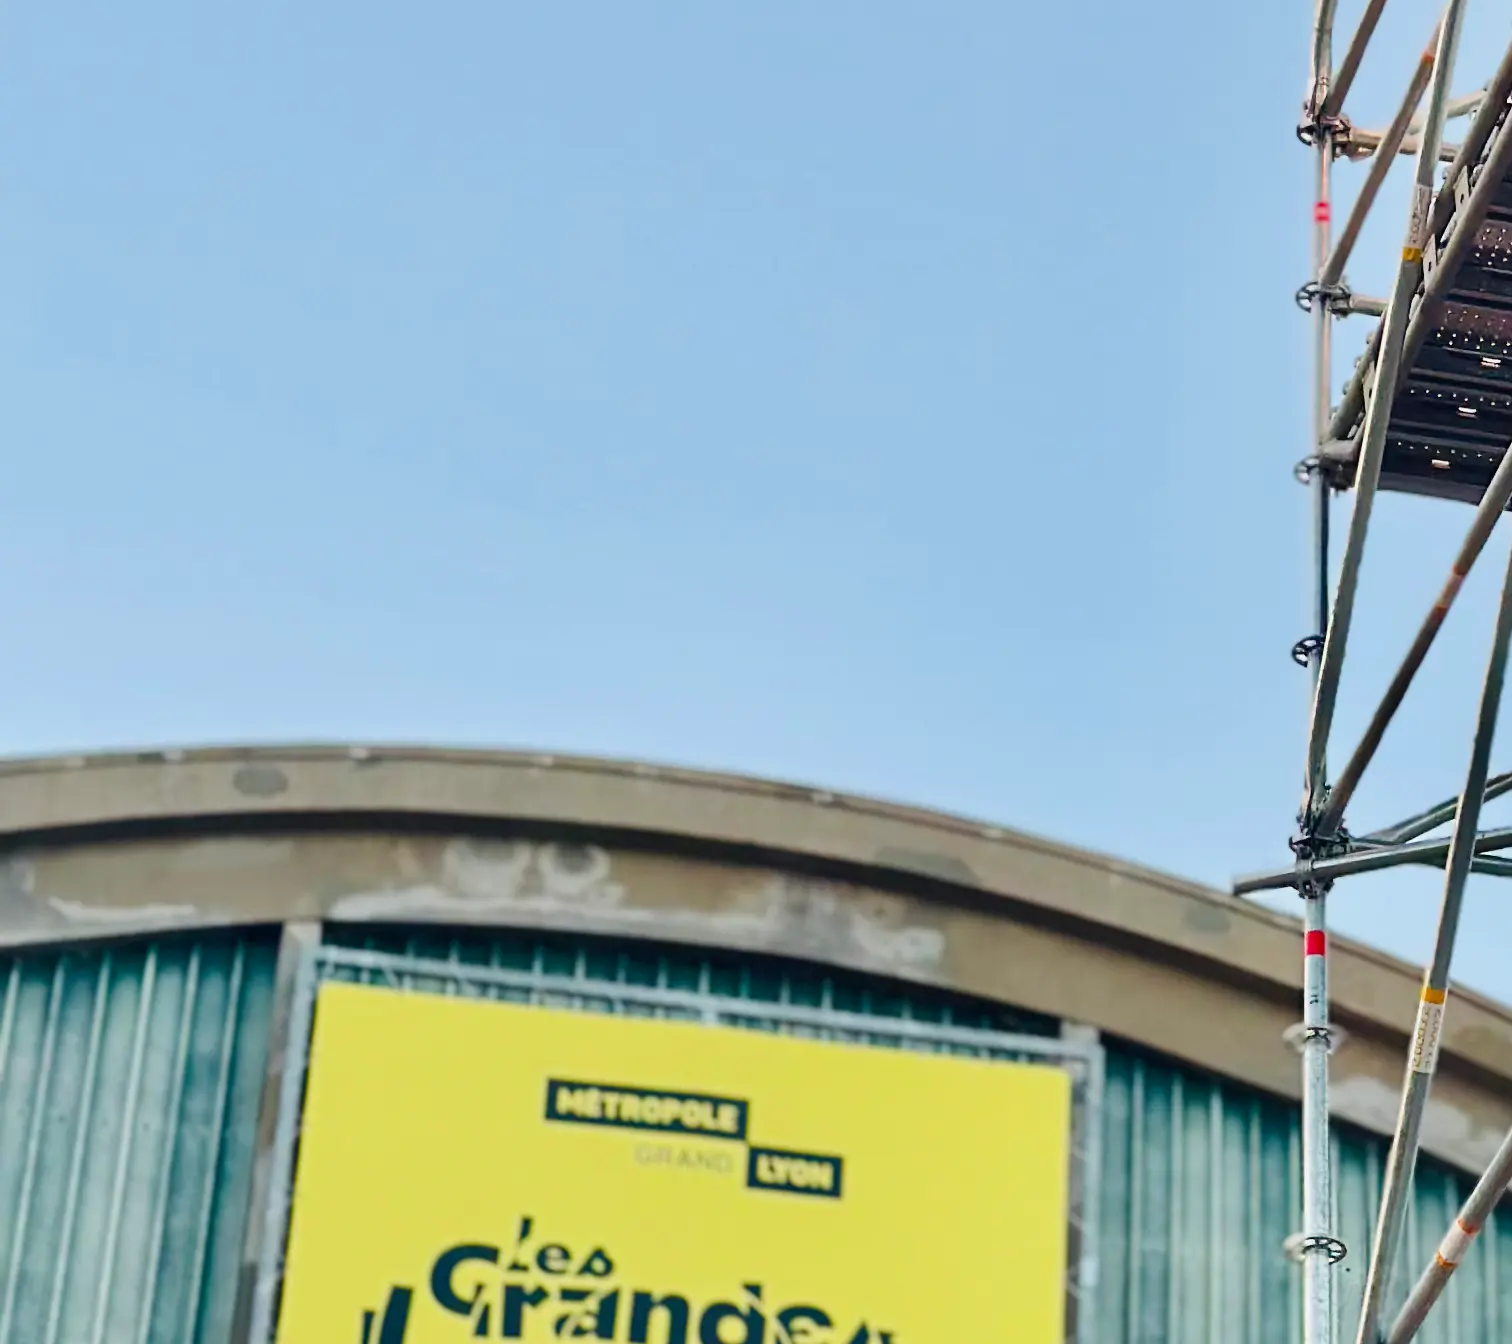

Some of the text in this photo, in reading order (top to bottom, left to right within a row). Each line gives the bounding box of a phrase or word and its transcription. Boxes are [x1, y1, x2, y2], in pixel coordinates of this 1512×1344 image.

[555, 1087, 739, 1133] MÉTROPOLE
[634, 1143, 735, 1174] GRAND
[756, 1153, 834, 1190] LYON
